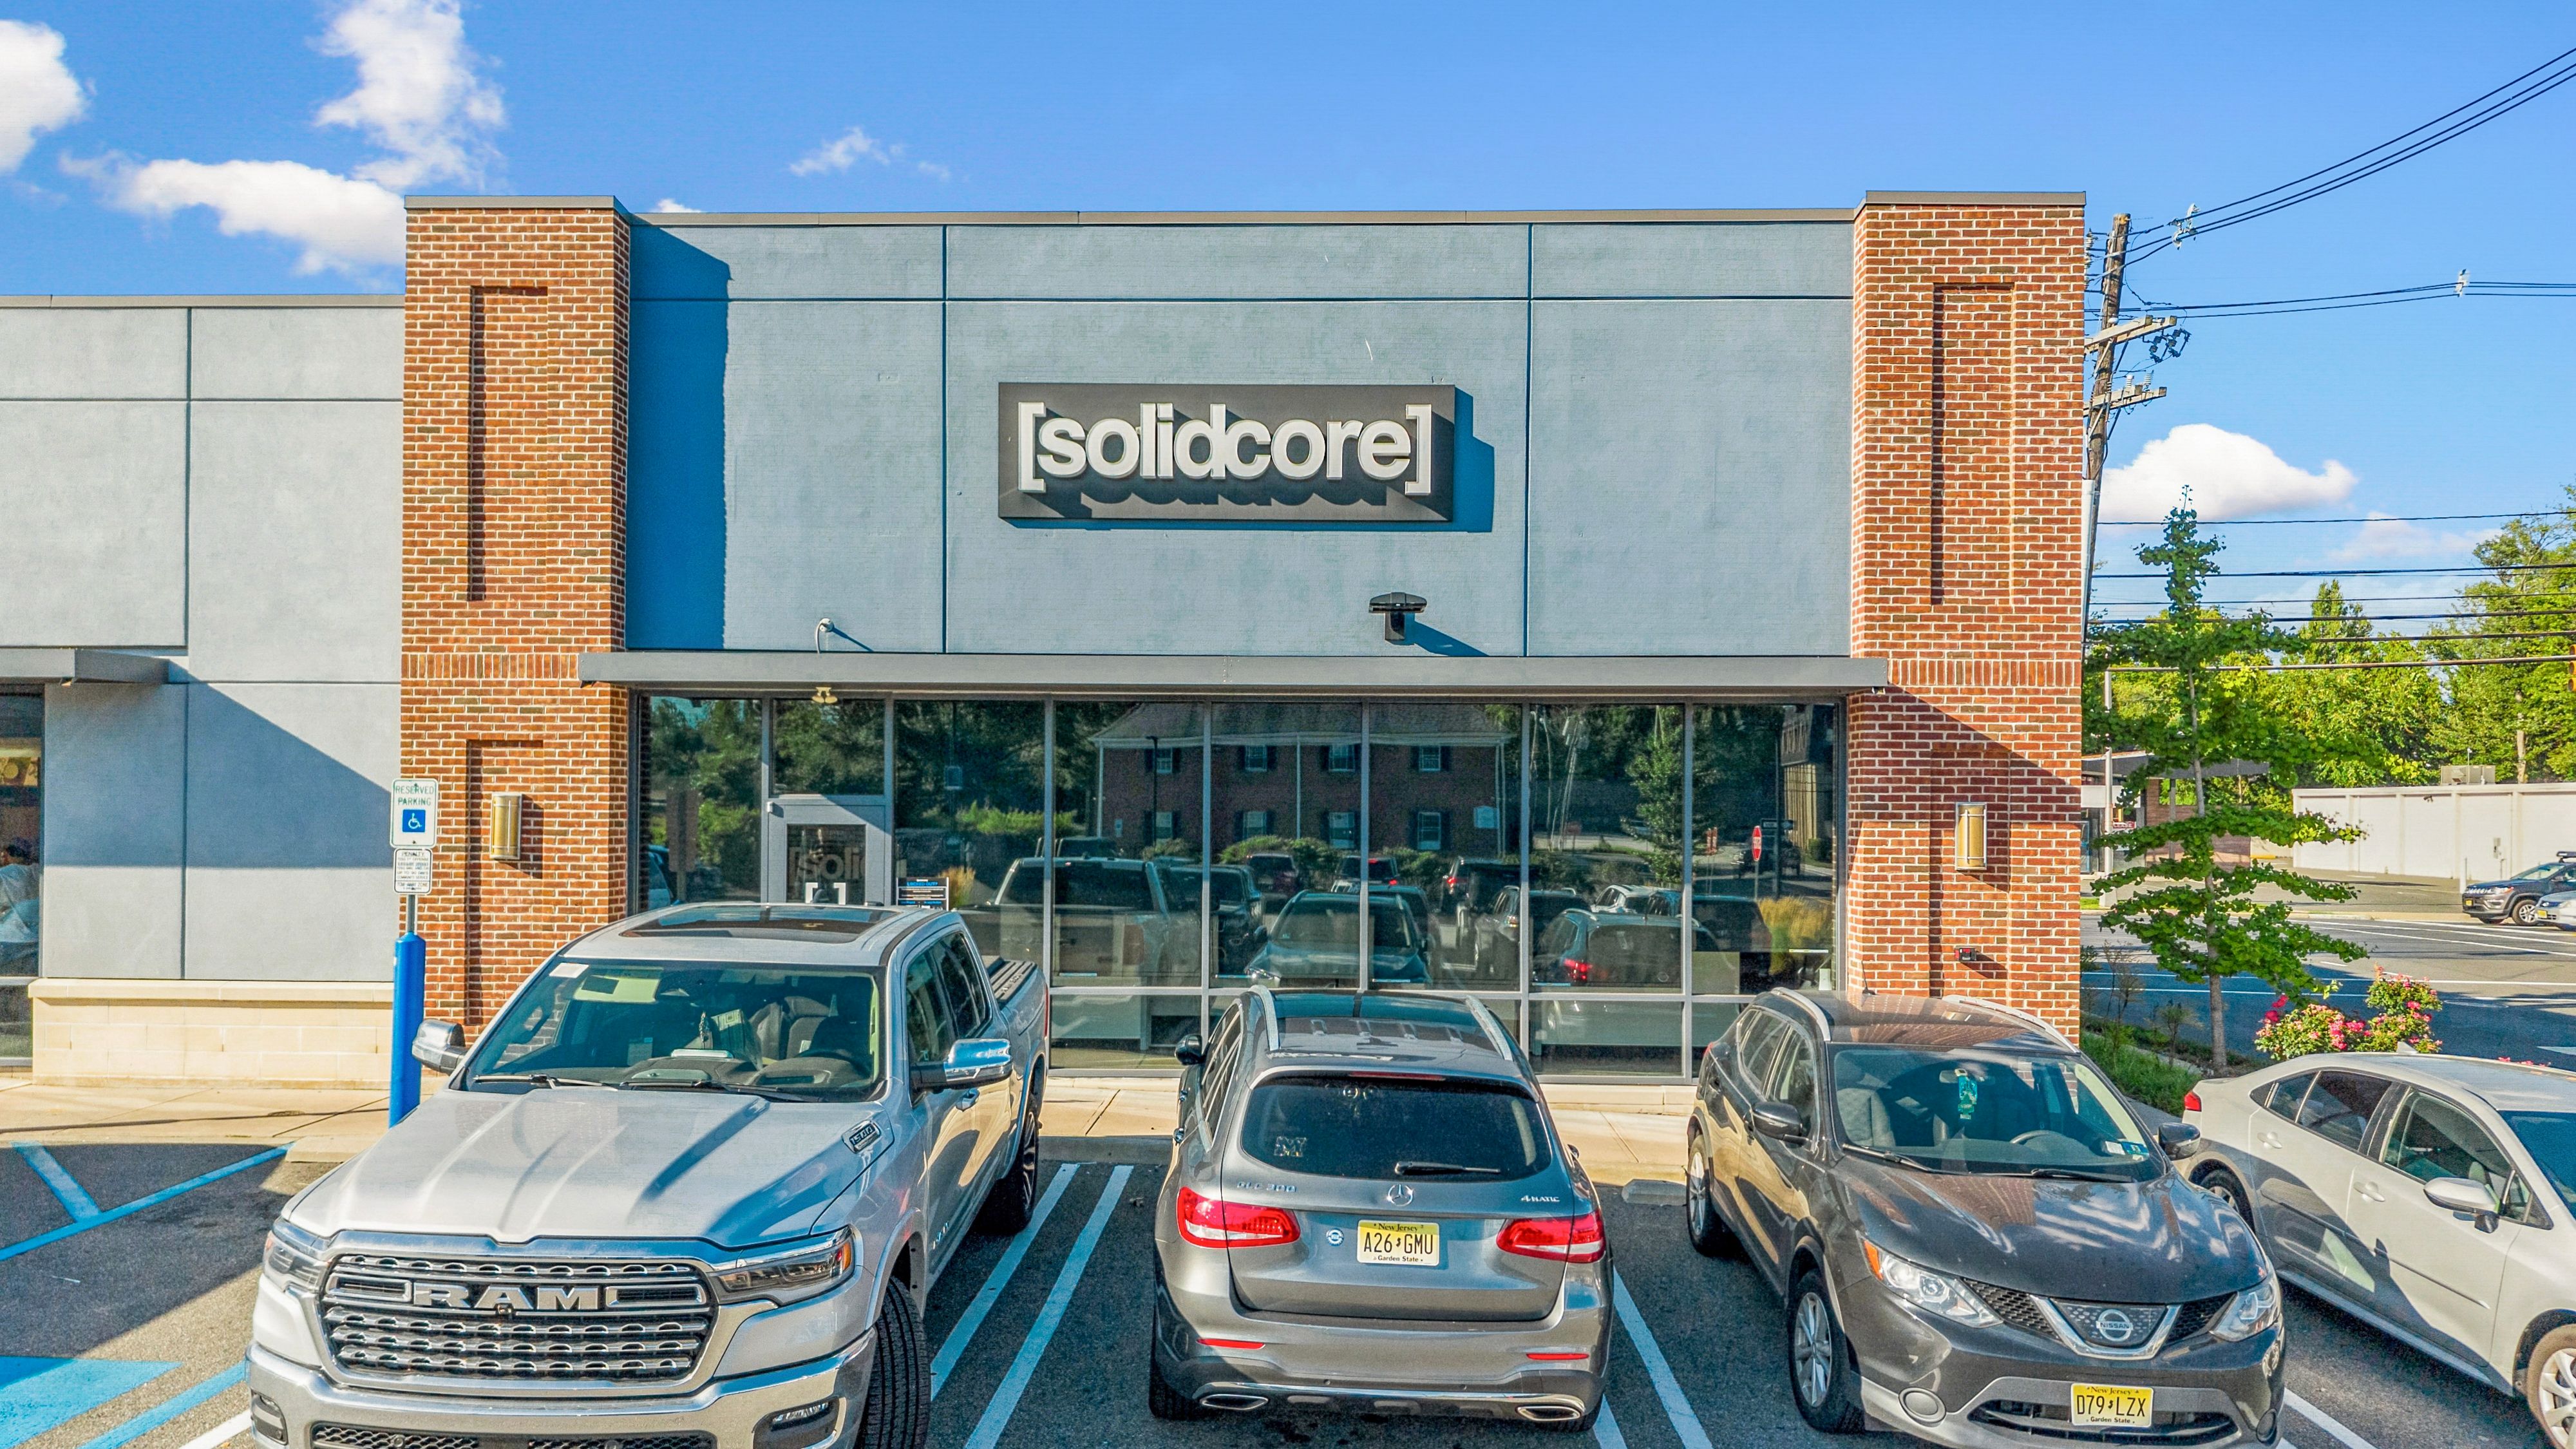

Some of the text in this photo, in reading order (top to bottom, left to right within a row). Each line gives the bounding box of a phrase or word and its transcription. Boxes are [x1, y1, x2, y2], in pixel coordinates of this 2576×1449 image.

[1018, 401, 1431, 496] [solidcore]
[395, 786, 434, 794] RESERVED
[398, 797, 431, 806] PARKING
[850, 1125, 873, 1144] 1500
[1267, 1184, 1297, 1192] 300
[1363, 1232, 1393, 1253] A26
[1404, 1234, 1434, 1255] GMU
[413, 1282, 599, 1310] RAM
[2109, 1387, 2132, 1396] Jersey
[2077, 1395, 2146, 1417] D79 LZX
